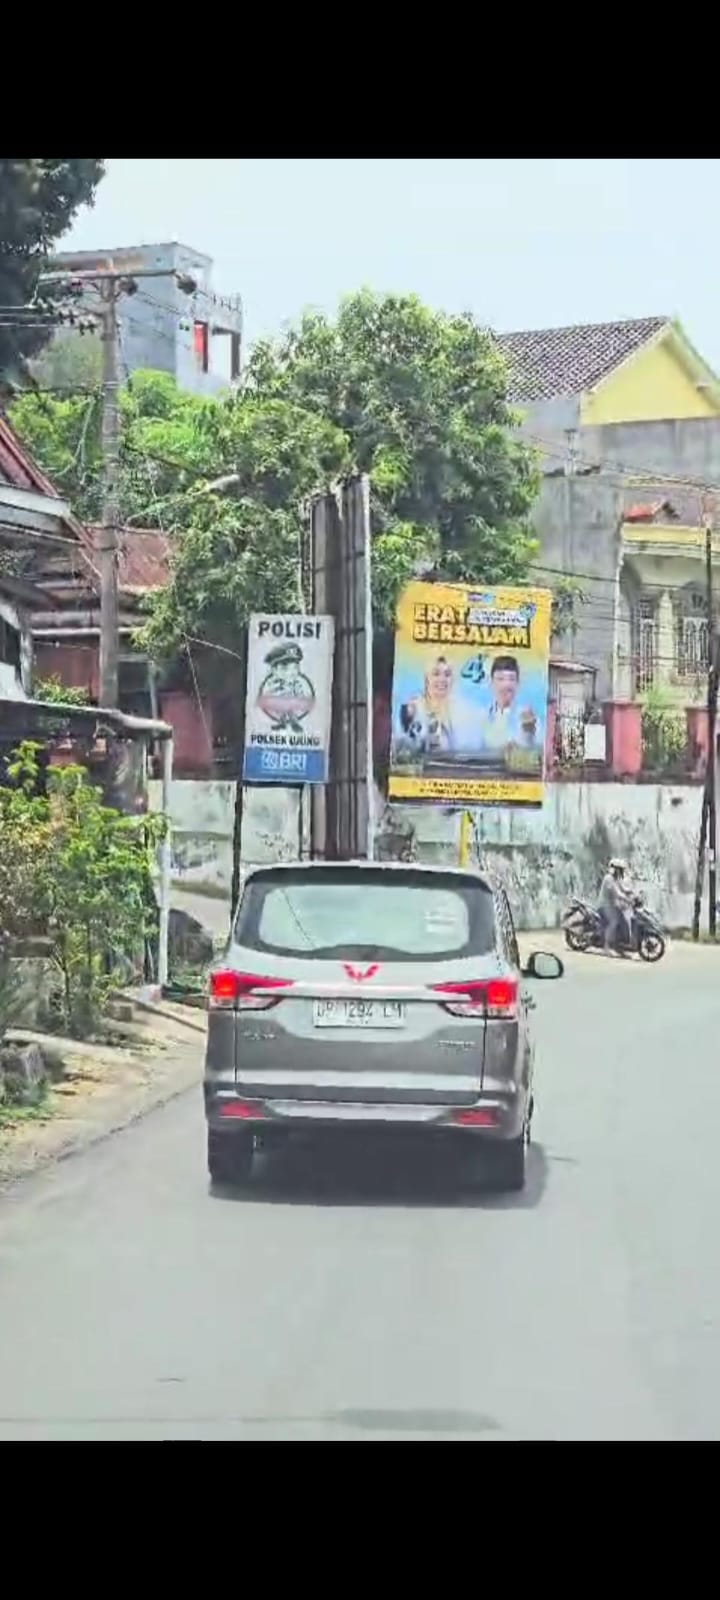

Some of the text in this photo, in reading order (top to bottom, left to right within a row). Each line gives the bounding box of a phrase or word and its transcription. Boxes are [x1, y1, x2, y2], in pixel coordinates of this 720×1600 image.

[414, 604, 469, 624] ERAT
[258, 621, 321, 639] POLISI
[413, 622, 530, 648] BERSALAM
[279, 752, 307, 770] BRI
